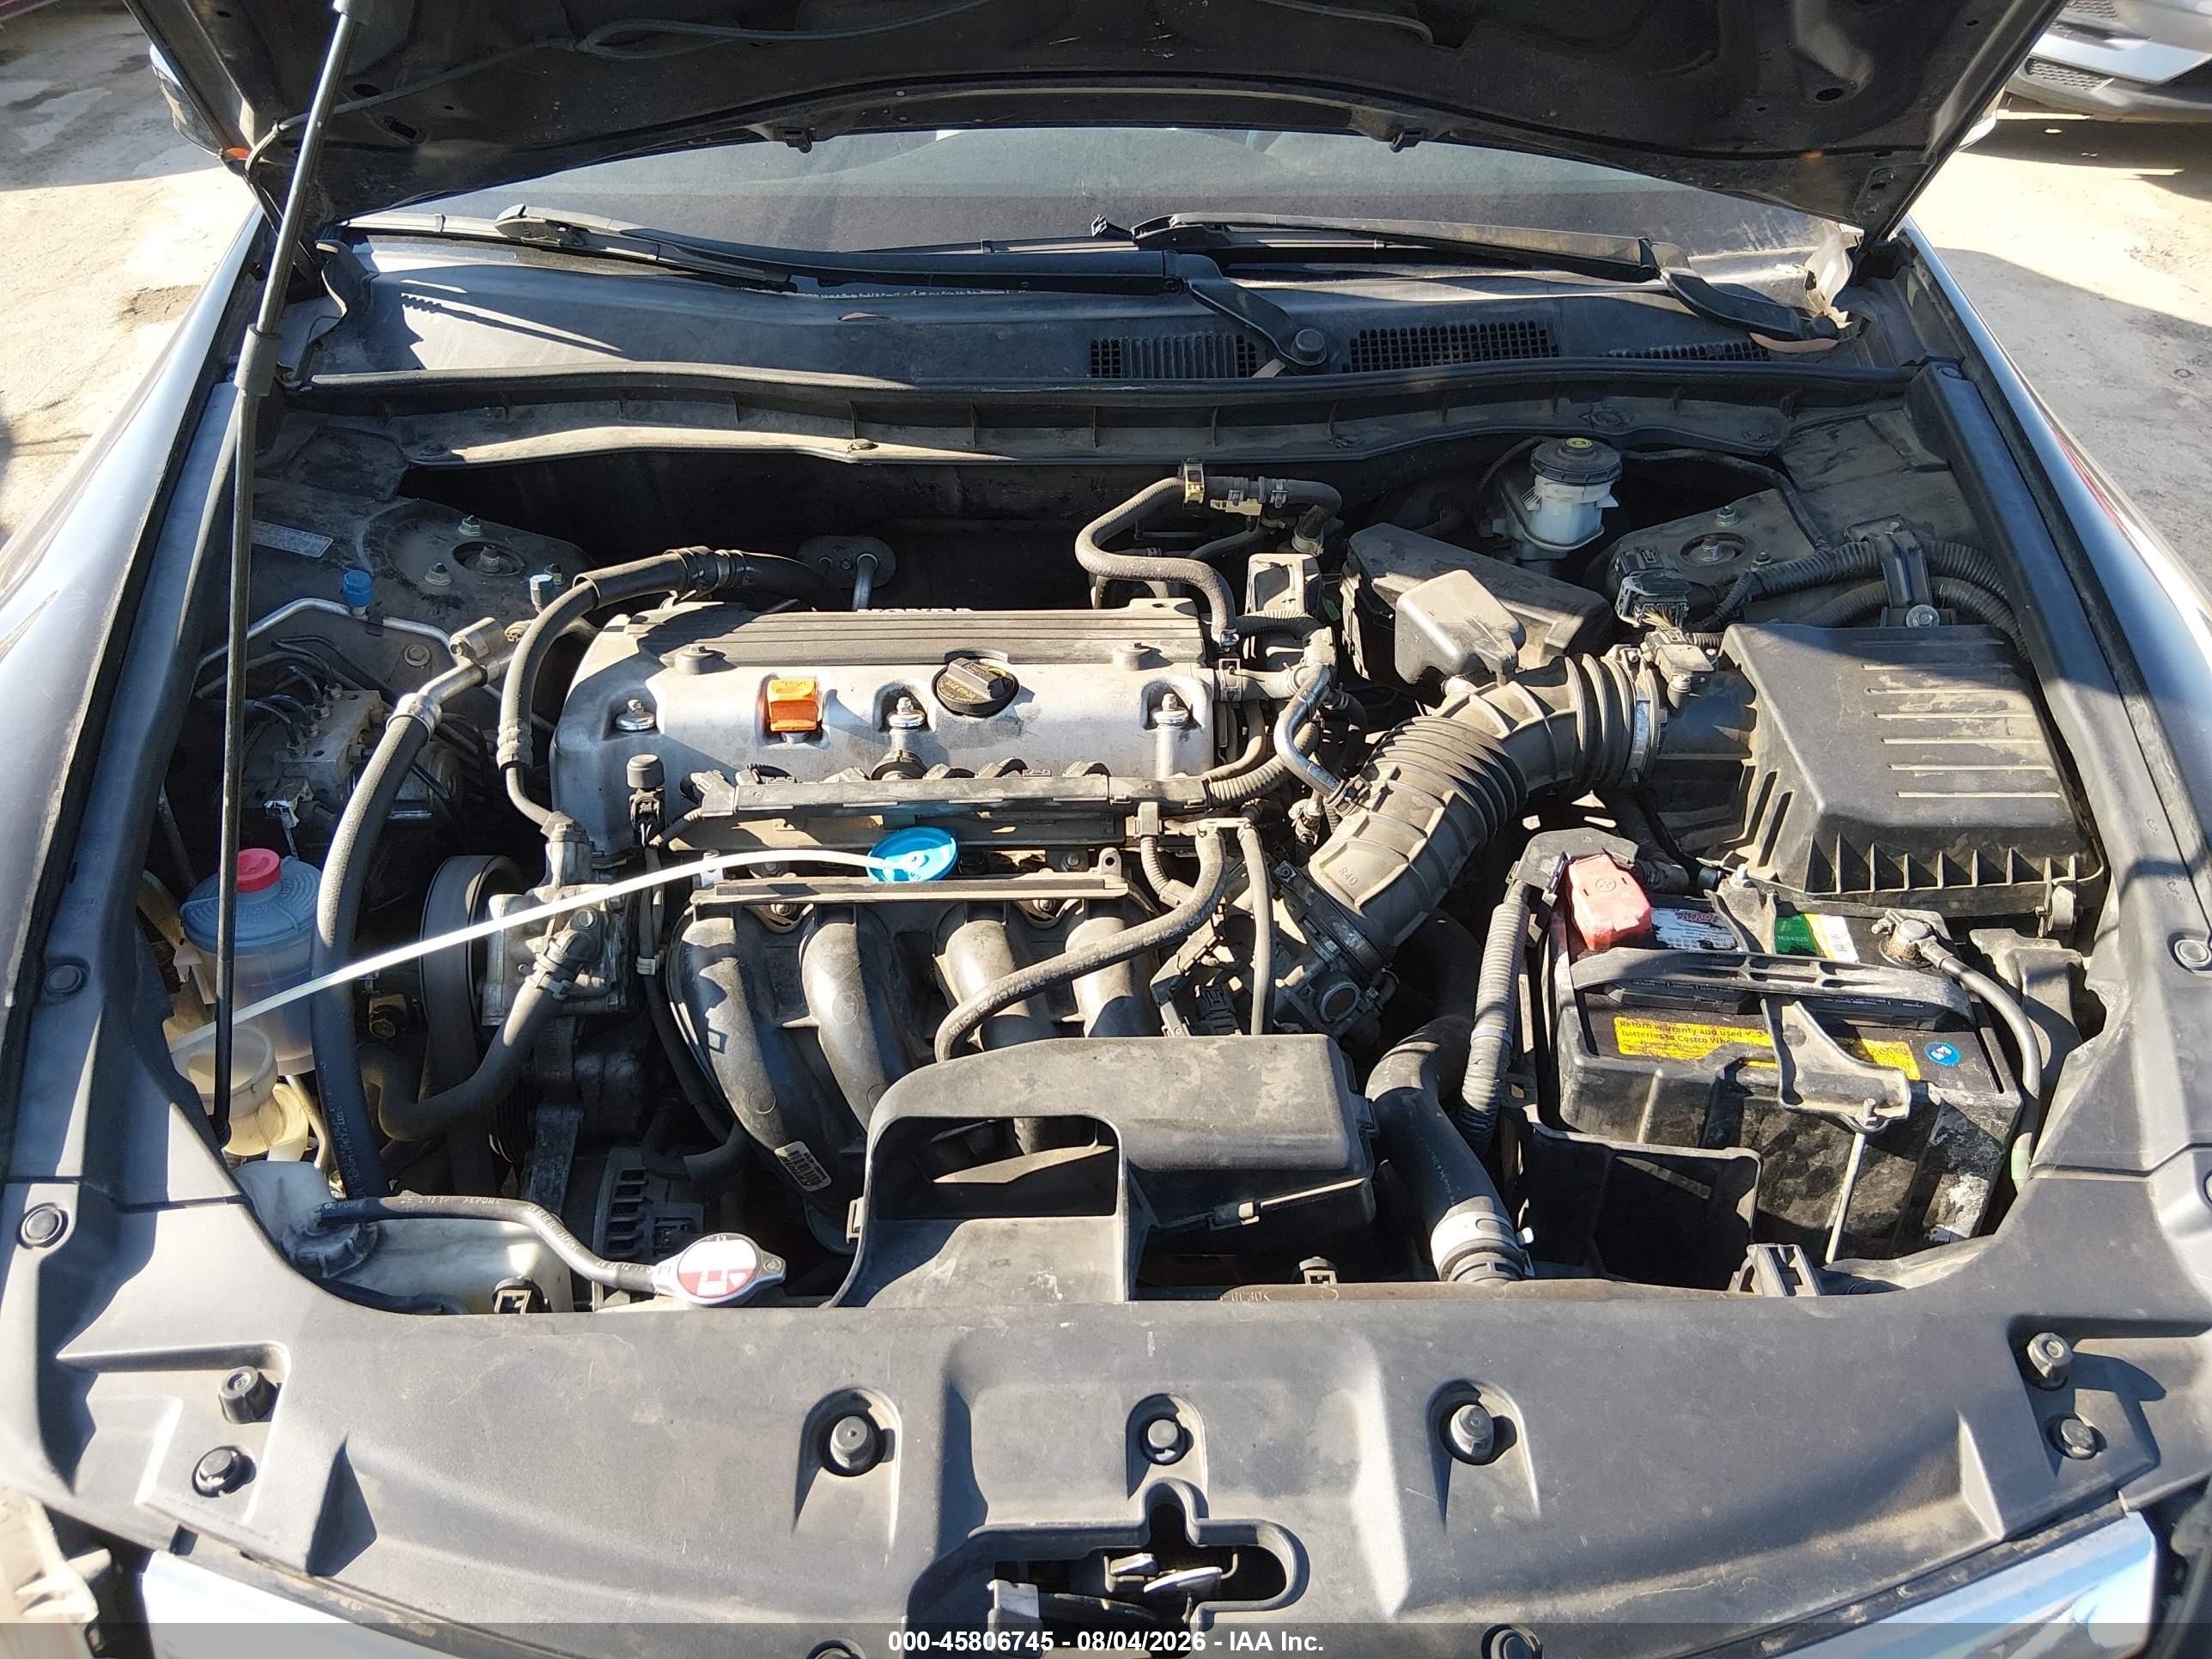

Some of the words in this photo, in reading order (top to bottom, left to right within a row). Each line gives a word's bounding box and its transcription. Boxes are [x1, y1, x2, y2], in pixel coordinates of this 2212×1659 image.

[1620, 1020, 1652, 1030] Return
[1654, 1024, 1698, 1036] warranty
[1719, 1029, 1742, 1038] used
[1621, 1030, 1664, 1041] batteries
[1677, 1034, 1708, 1045] Costco
